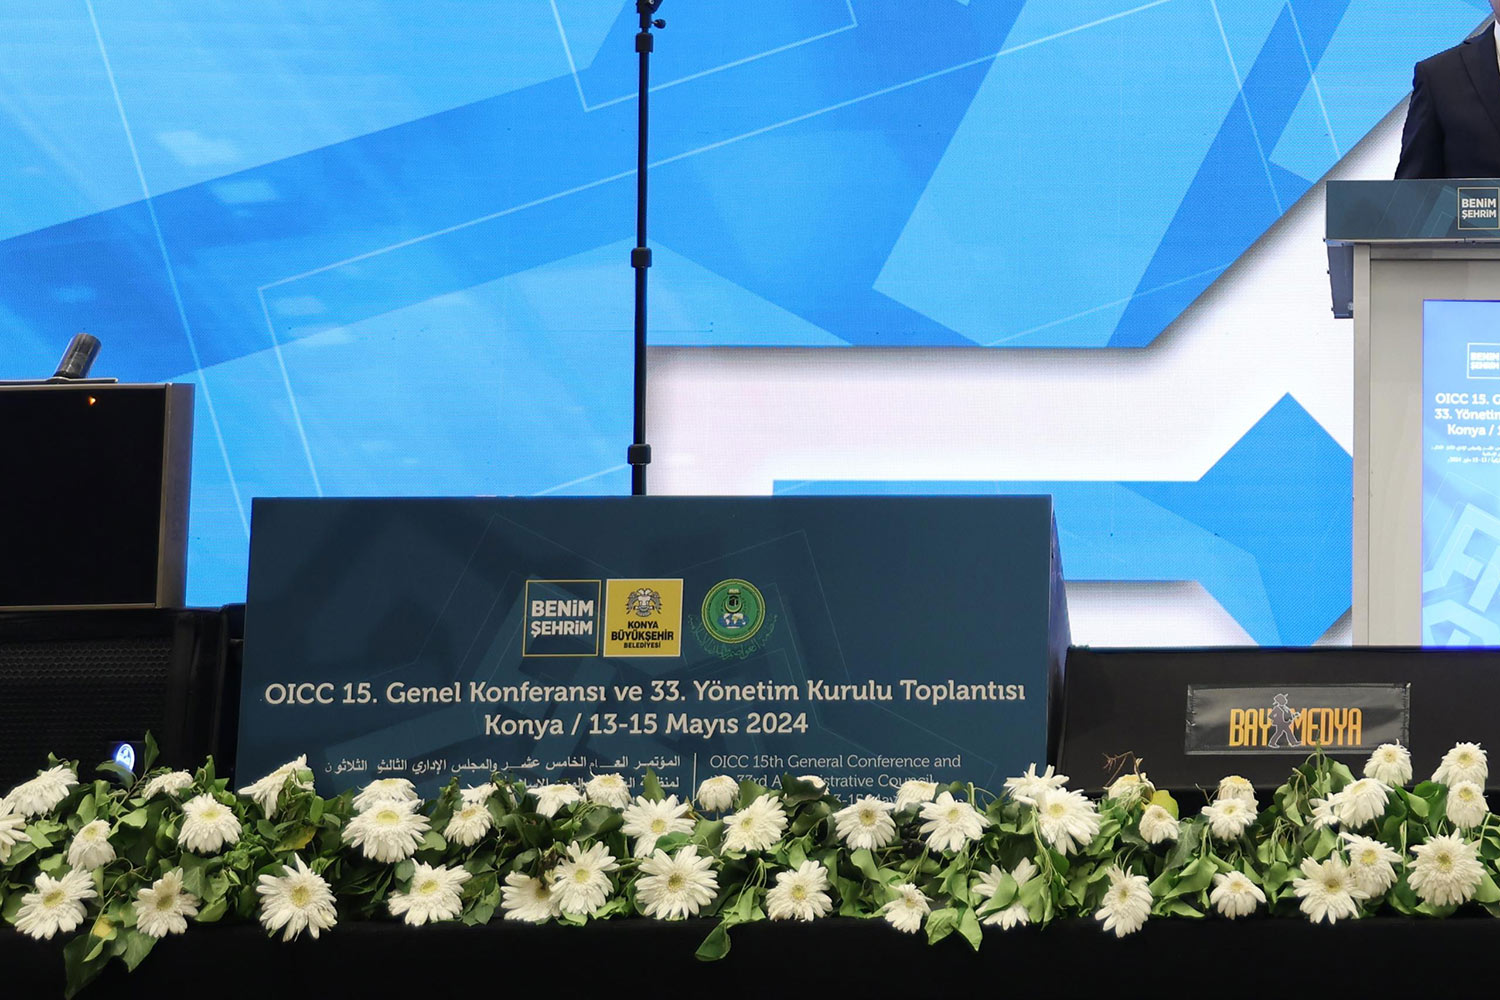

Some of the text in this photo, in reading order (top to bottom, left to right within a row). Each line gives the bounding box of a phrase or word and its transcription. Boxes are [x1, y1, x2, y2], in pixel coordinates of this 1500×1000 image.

[1435, 393, 1469, 405] OICC
[1471, 393, 1489, 405] 15.
[1434, 408, 1452, 420] 33.
[1447, 424, 1486, 438] Konya
[1488, 424, 1494, 436] /
[627, 620, 659, 630] KONYA
[610, 627, 674, 643] BÜYÜKŞEHİR
[265, 679, 1026, 706] OICC 15. Genel Konferansı ve 33. Yönetim Kurulu Toplantısı
[484, 712, 809, 740] Konya / 13-15 Mayıs 2024
[1228, 707, 1363, 747] BAY MEDYA
[411, 759, 447, 775] الإداري
[451, 758, 498, 773] والمجلس
[545, 756, 587, 771] الخامس
[709, 754, 961, 768] OICC 15th General Conference and
